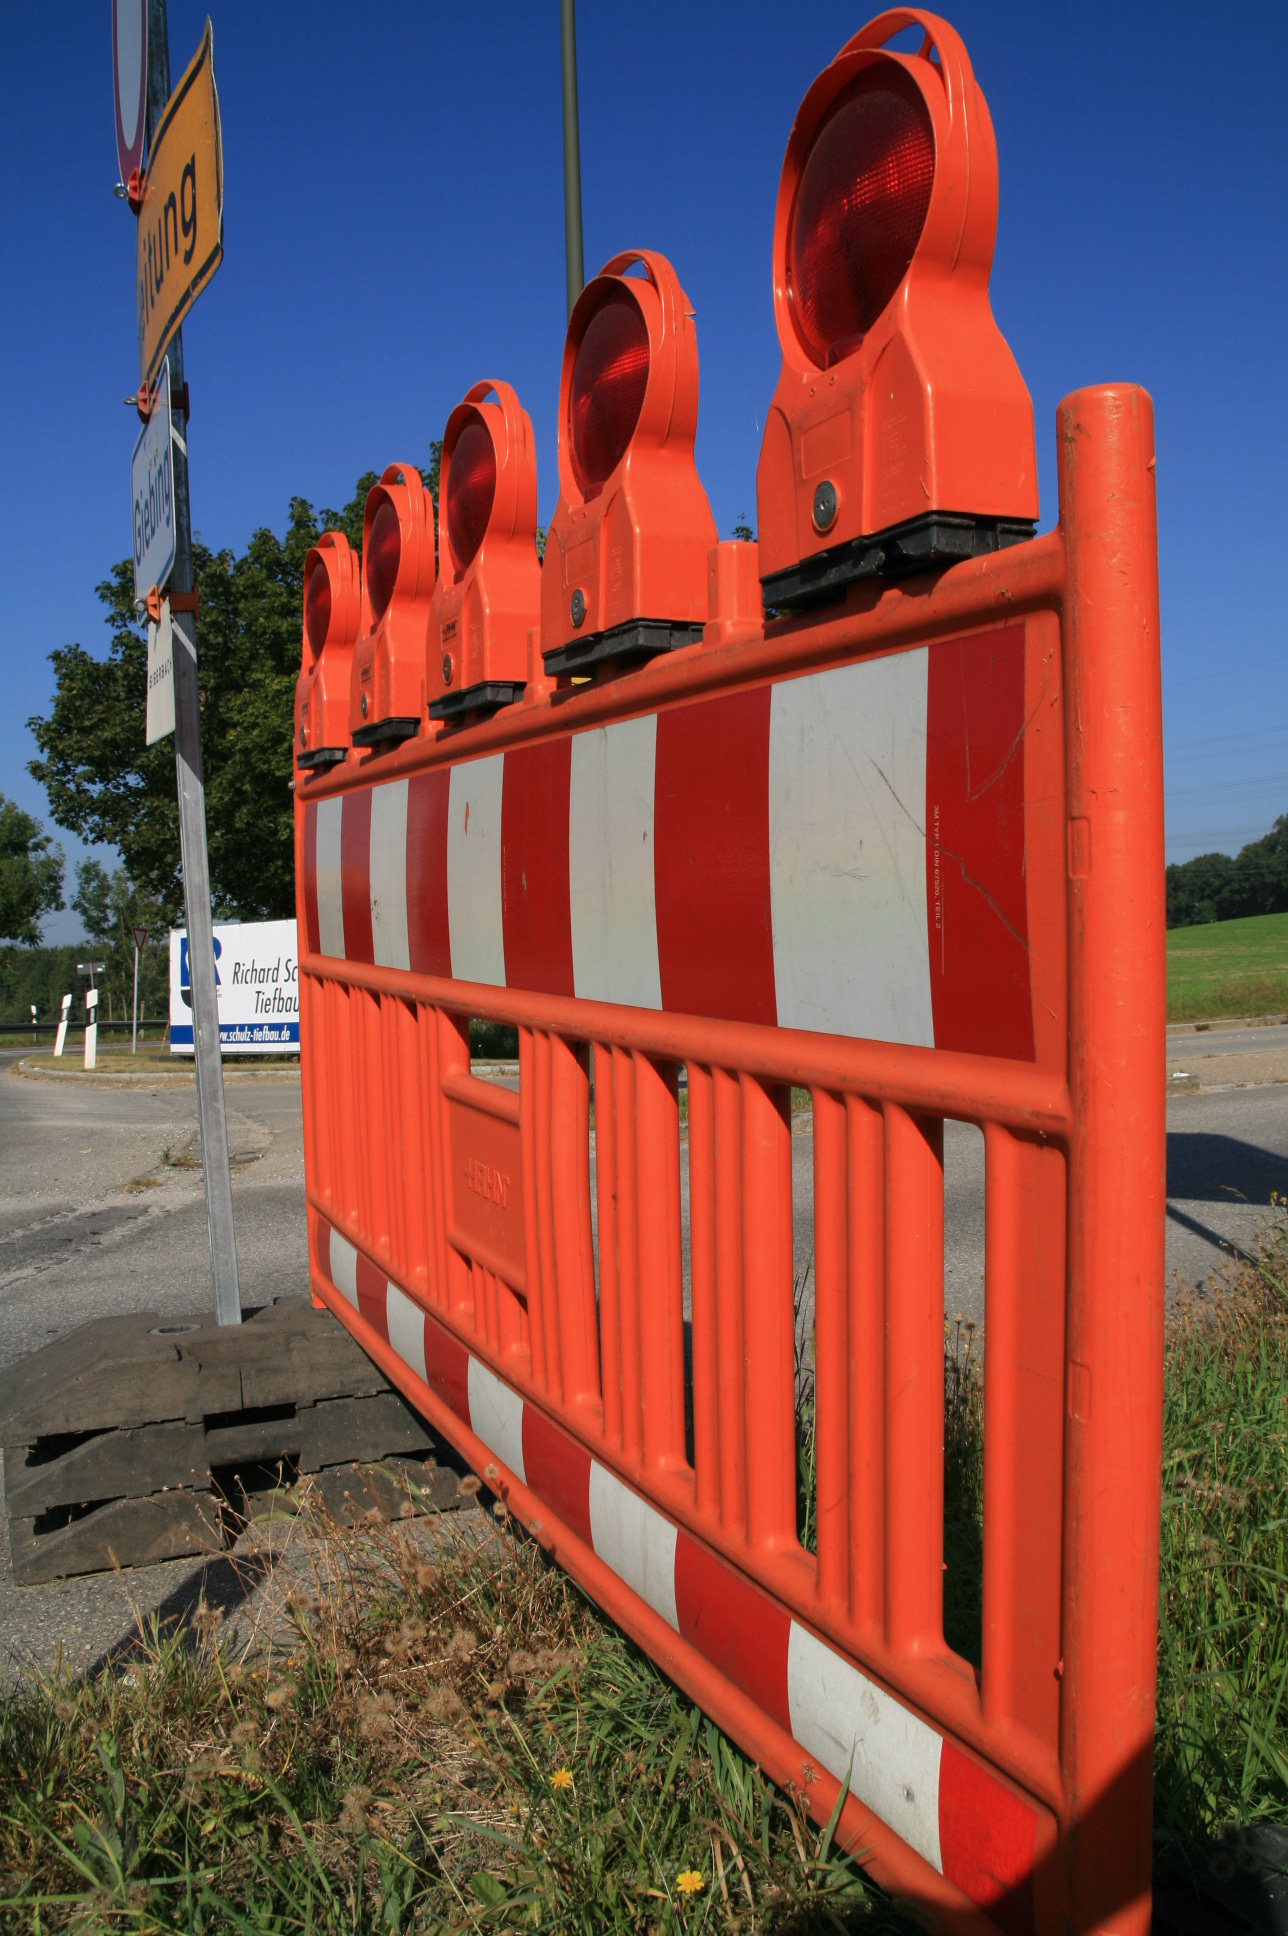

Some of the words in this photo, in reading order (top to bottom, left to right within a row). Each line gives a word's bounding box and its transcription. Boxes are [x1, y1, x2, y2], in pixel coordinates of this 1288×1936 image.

[134, 445, 172, 567] Giebing
[933, 805, 939, 819] 3M
[232, 957, 281, 985] Richard
[284, 958, 298, 982] Sc
[255, 987, 299, 1014] Tiefbau
[219, 1024, 291, 1042] w.schulz-tiefbau.de
